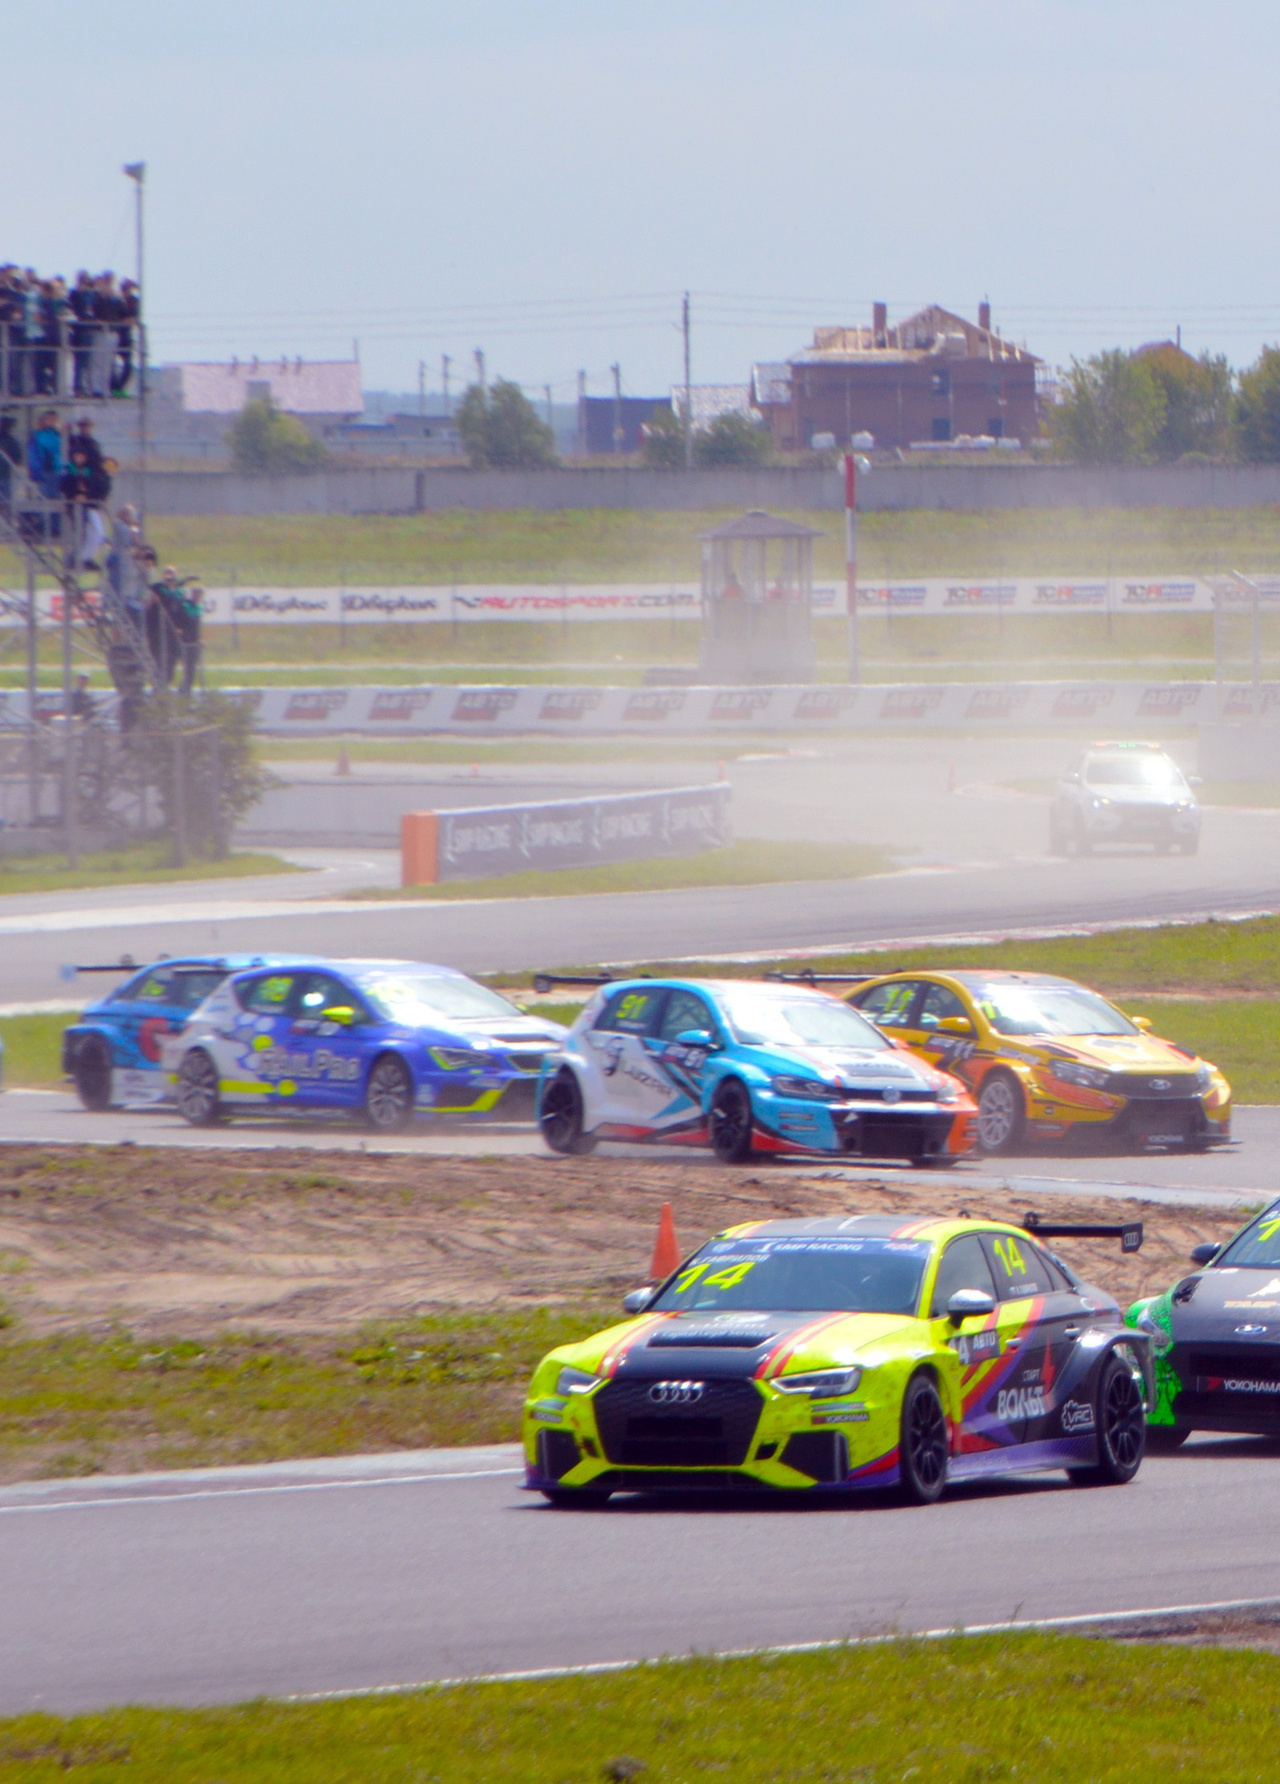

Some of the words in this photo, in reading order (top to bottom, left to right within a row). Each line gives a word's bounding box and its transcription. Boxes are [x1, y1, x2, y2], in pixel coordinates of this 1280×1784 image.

[617, 995, 647, 1018] 91
[774, 1243, 803, 1251] SMP
[806, 1243, 864, 1252] RACING
[993, 1237, 1027, 1277] 14
[674, 1261, 756, 1293] 14
